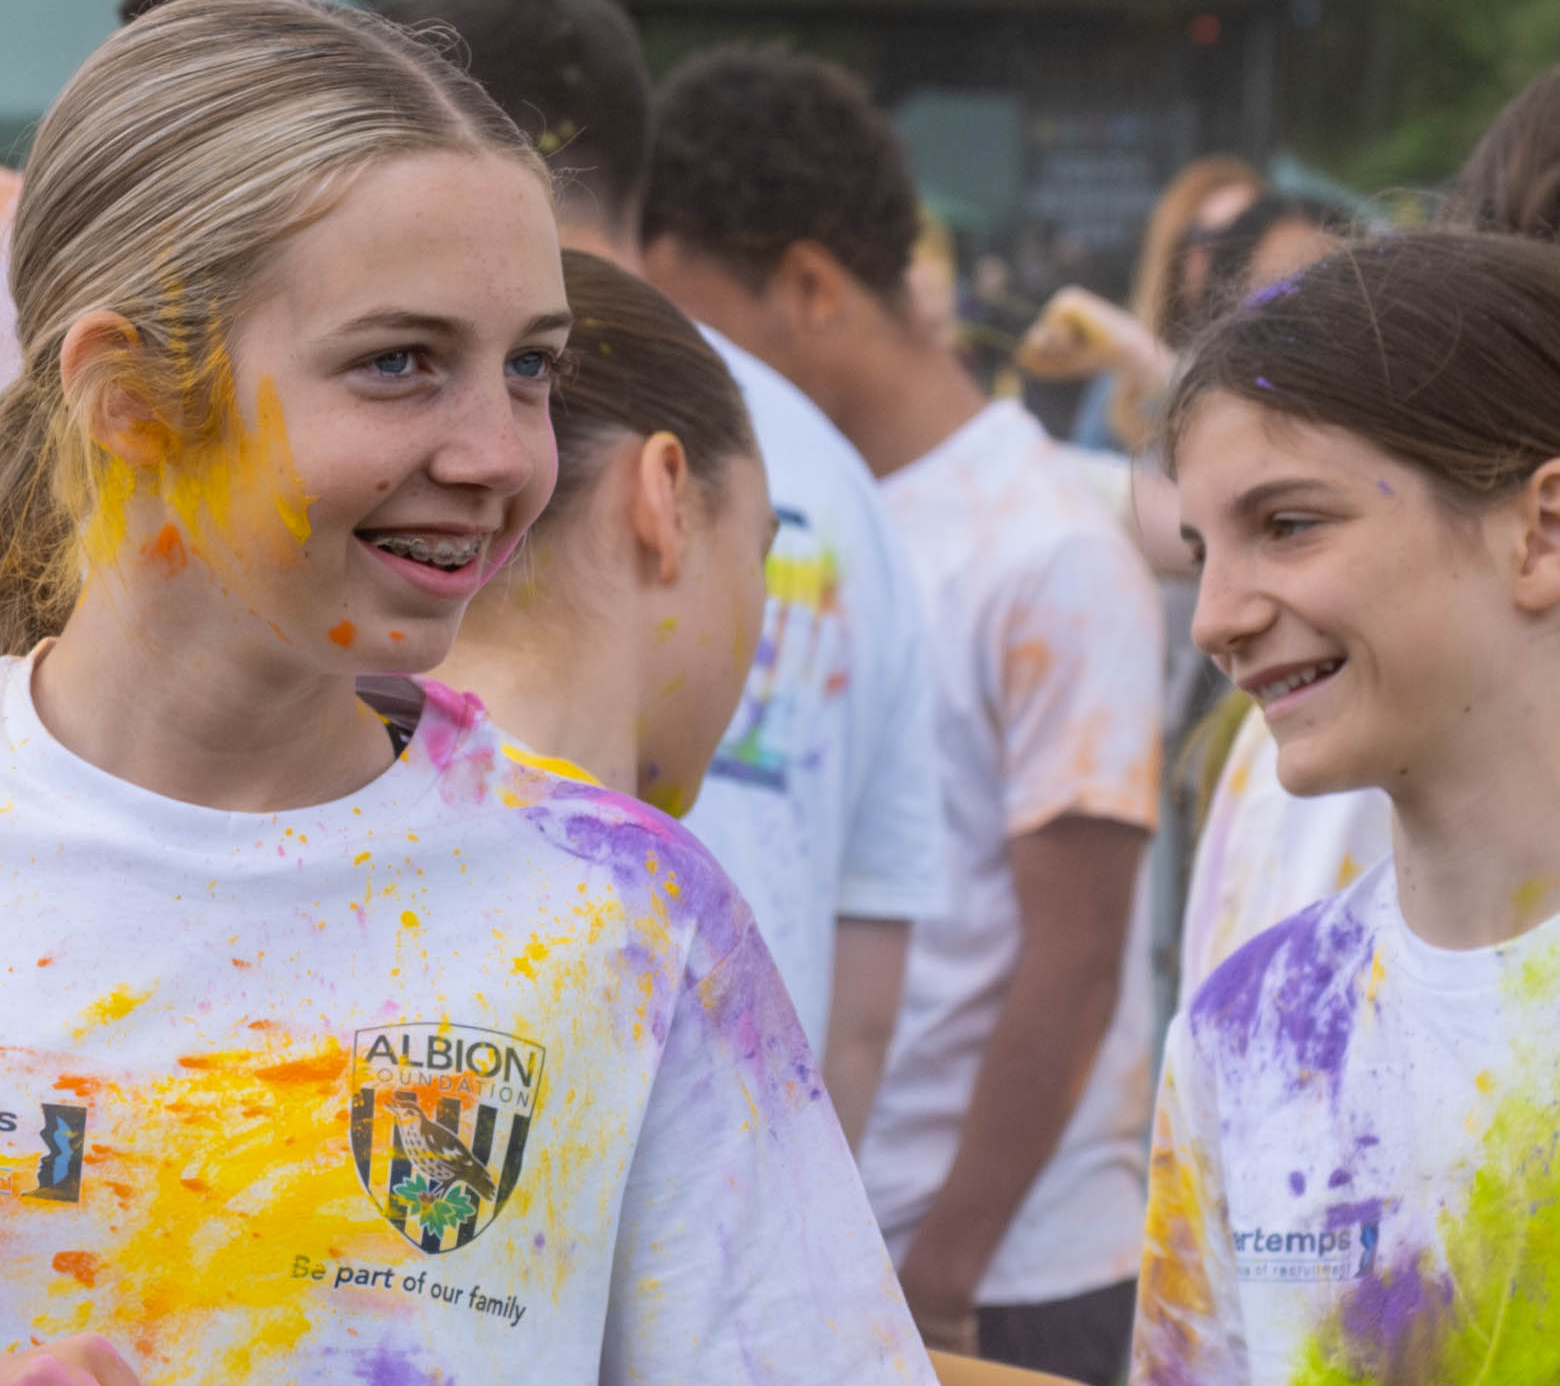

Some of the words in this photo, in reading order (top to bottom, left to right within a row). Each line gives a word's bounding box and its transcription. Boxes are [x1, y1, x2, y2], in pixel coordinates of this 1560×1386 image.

[366, 1034, 535, 1087] ALBION
[376, 1068, 530, 1107] OUNDATION
[290, 1255, 327, 1280] Be
[334, 1264, 395, 1290] part
[403, 1271, 427, 1295] of
[431, 1282, 463, 1306] our
[468, 1284, 527, 1328] family
